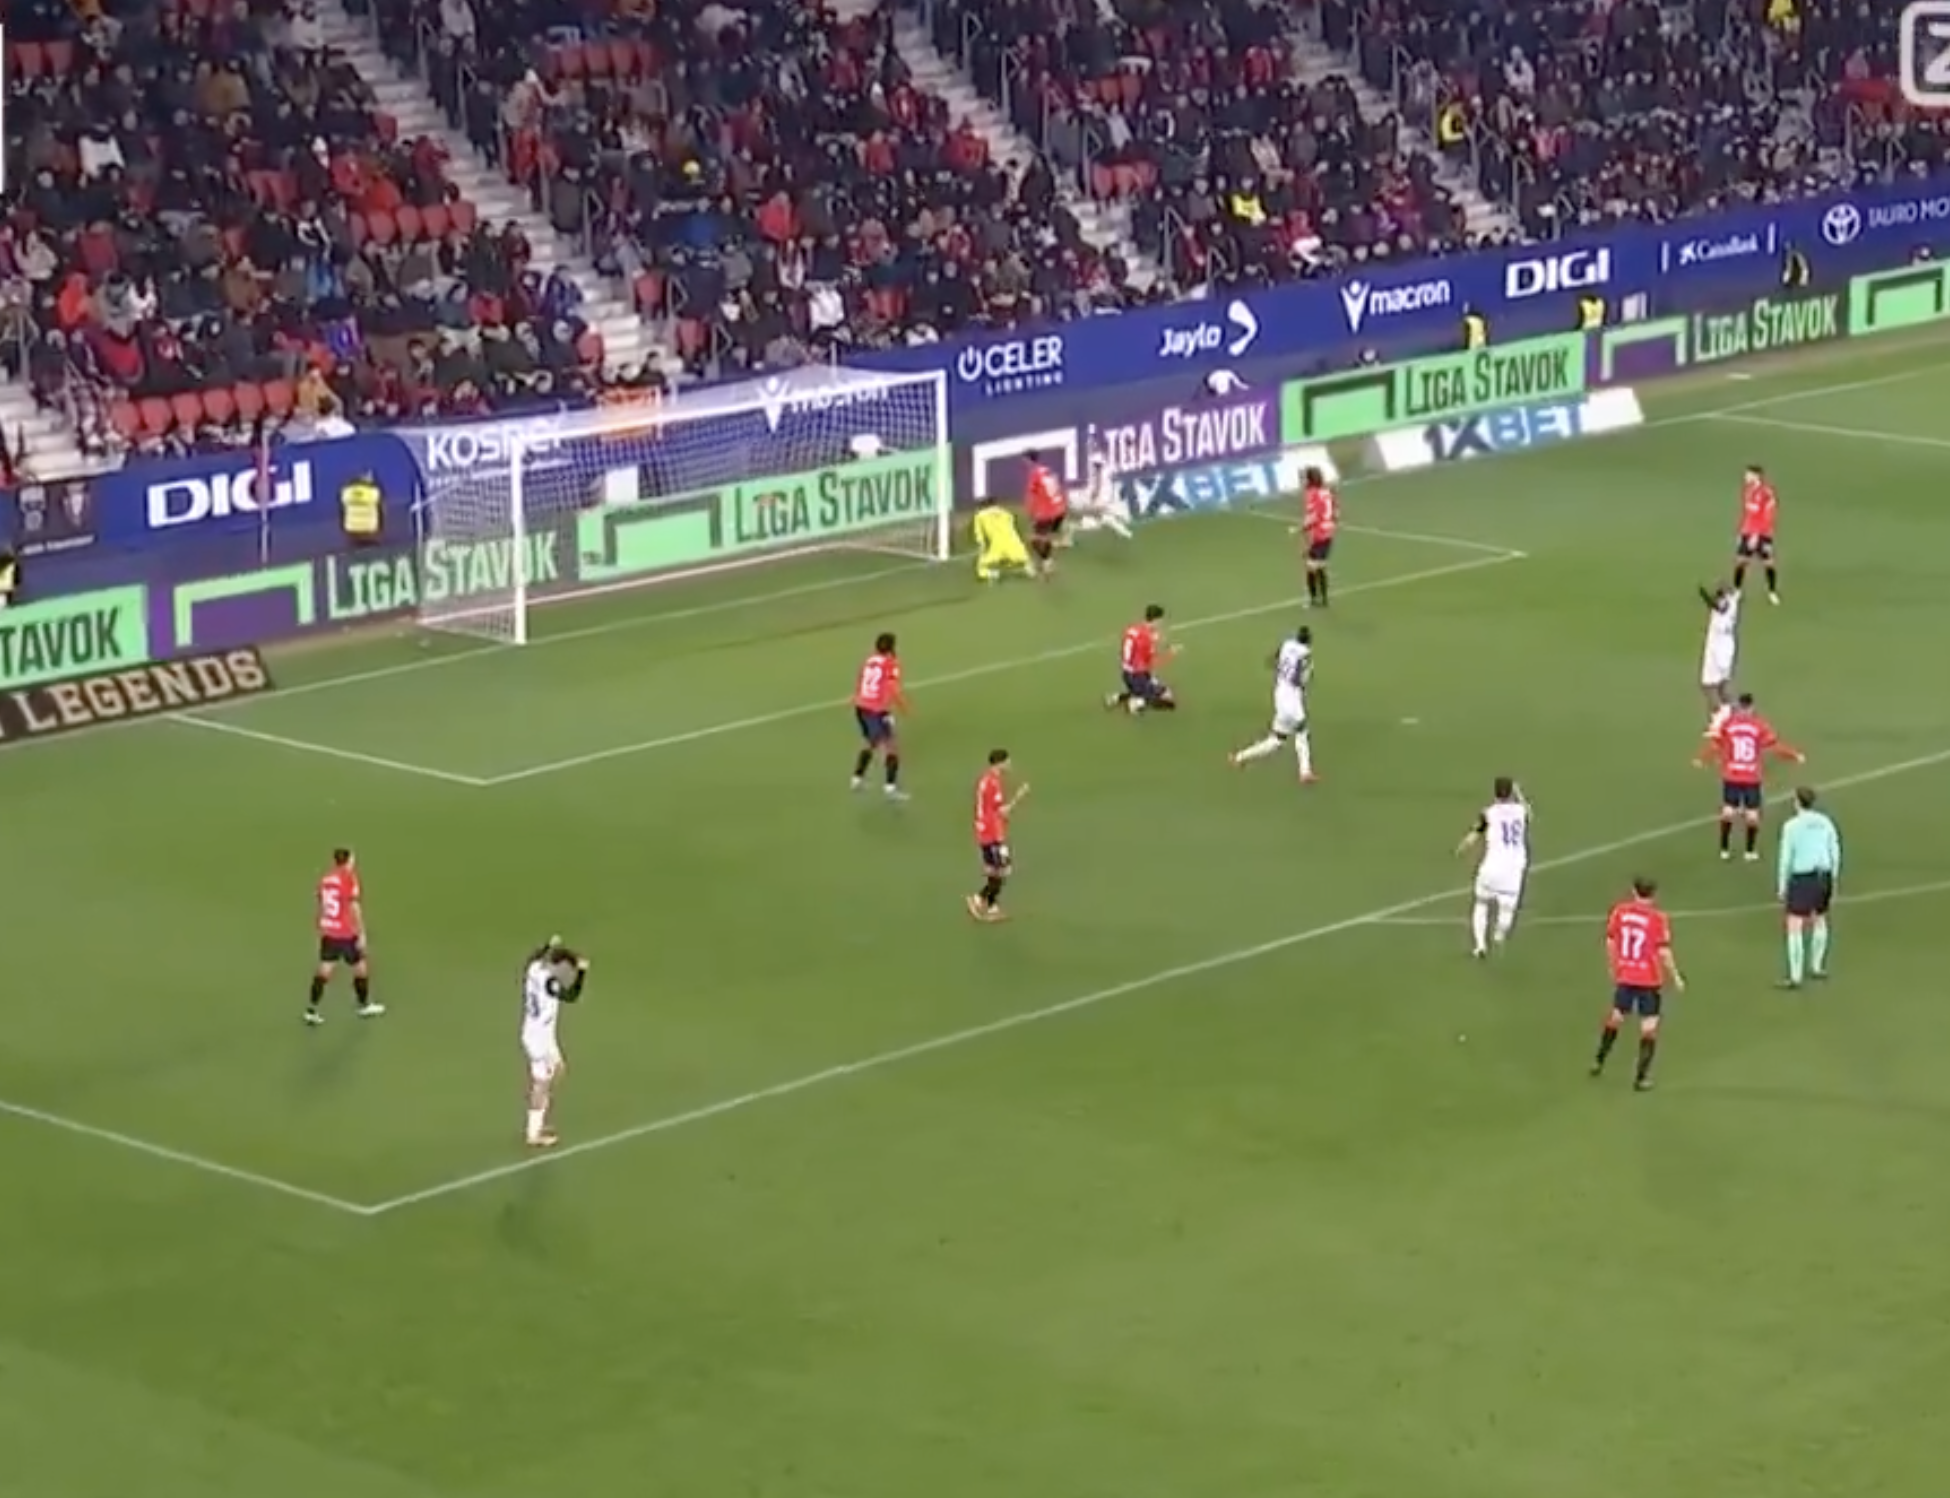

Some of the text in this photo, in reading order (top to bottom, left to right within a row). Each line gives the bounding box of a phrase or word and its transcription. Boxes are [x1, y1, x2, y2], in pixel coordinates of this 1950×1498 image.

[1370, 279, 1451, 316] macron
[1505, 248, 1610, 299] DIGI
[985, 335, 1062, 377] CELER
[1694, 295, 1838, 362] LIGA STAVOK
[1405, 352, 1568, 415] LIGA STAVOK
[1098, 402, 1267, 475] IGA STAVOK
[148, 461, 313, 527] DIGI
[735, 470, 933, 543] LIGA STAVOK
[327, 555, 417, 619] LIGA
[9, 650, 266, 732] LEGENDS
[1621, 925, 1645, 959] 17
